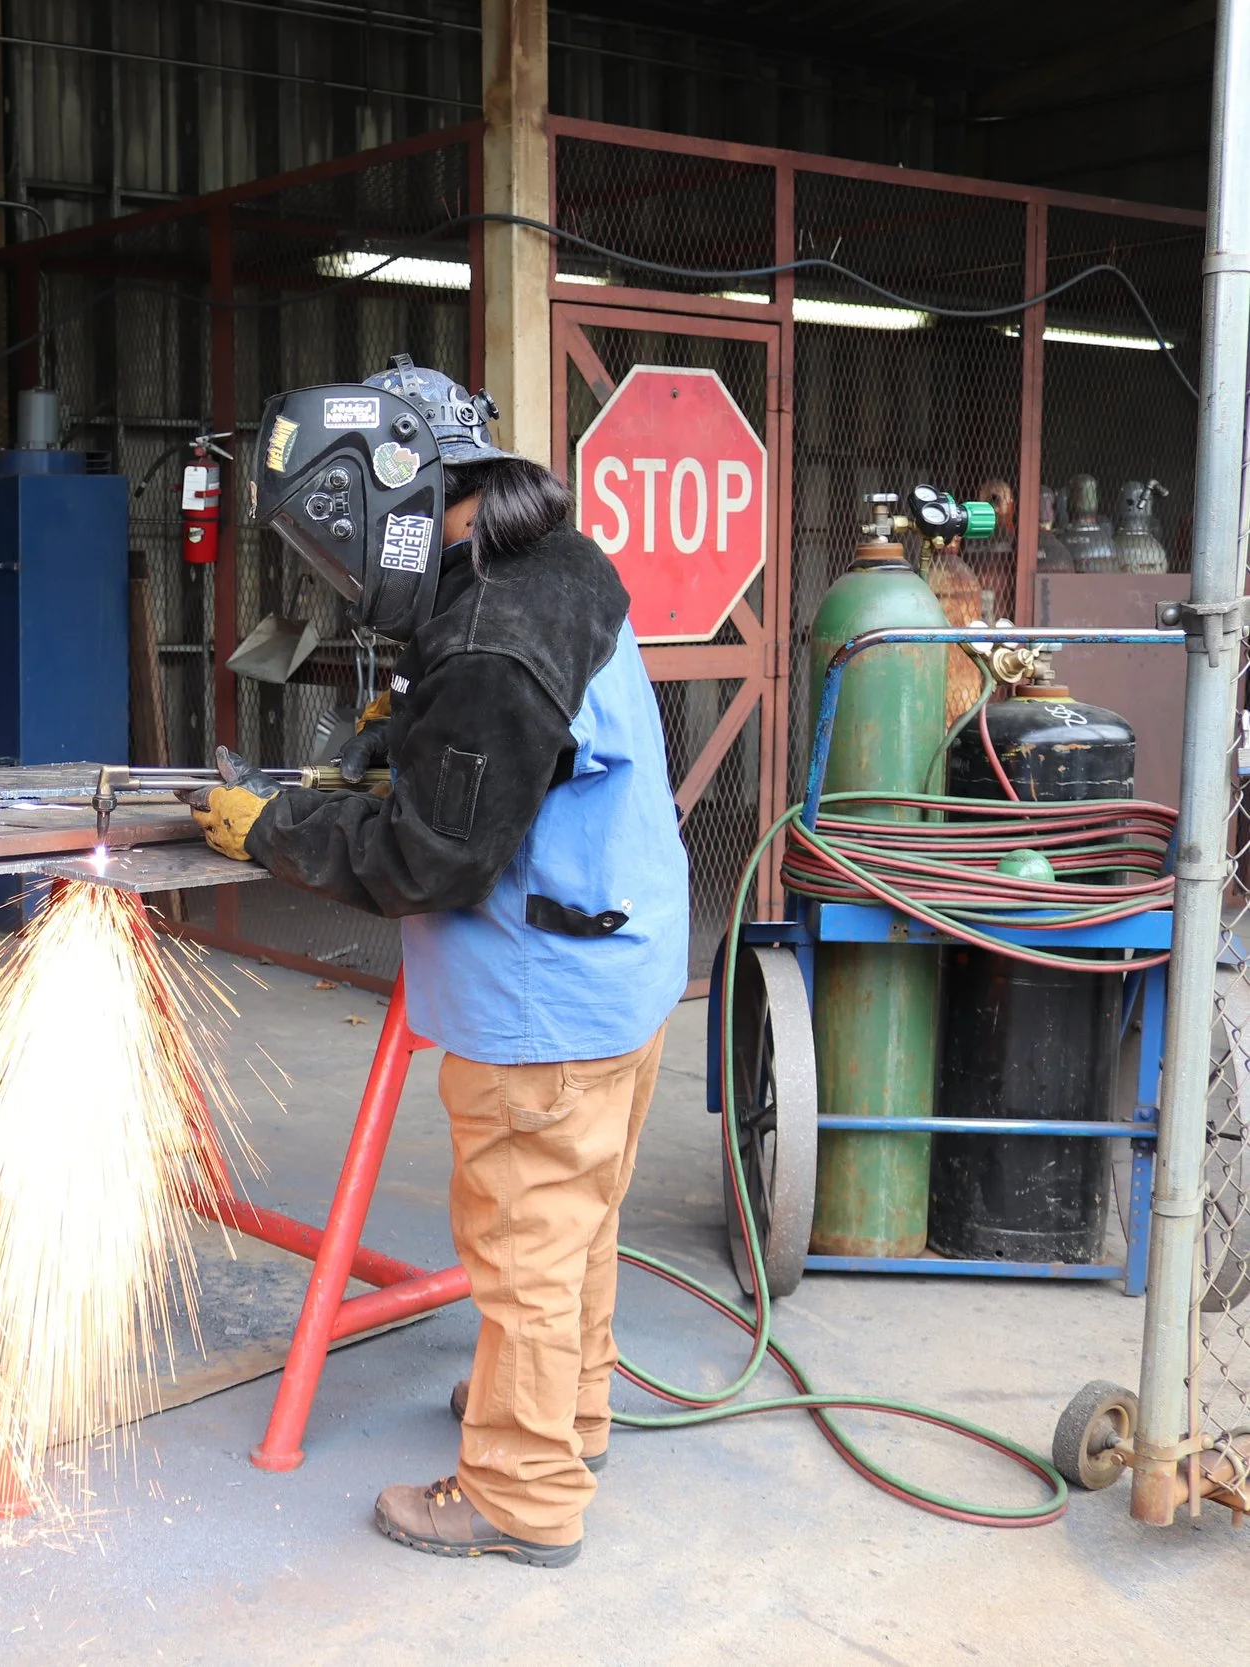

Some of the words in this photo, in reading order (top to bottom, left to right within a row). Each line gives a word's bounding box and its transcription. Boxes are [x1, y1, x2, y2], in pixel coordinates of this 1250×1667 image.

[591, 455, 753, 556] STOP
[383, 516, 407, 567] BLACK
[401, 517, 425, 570] QUEEN
